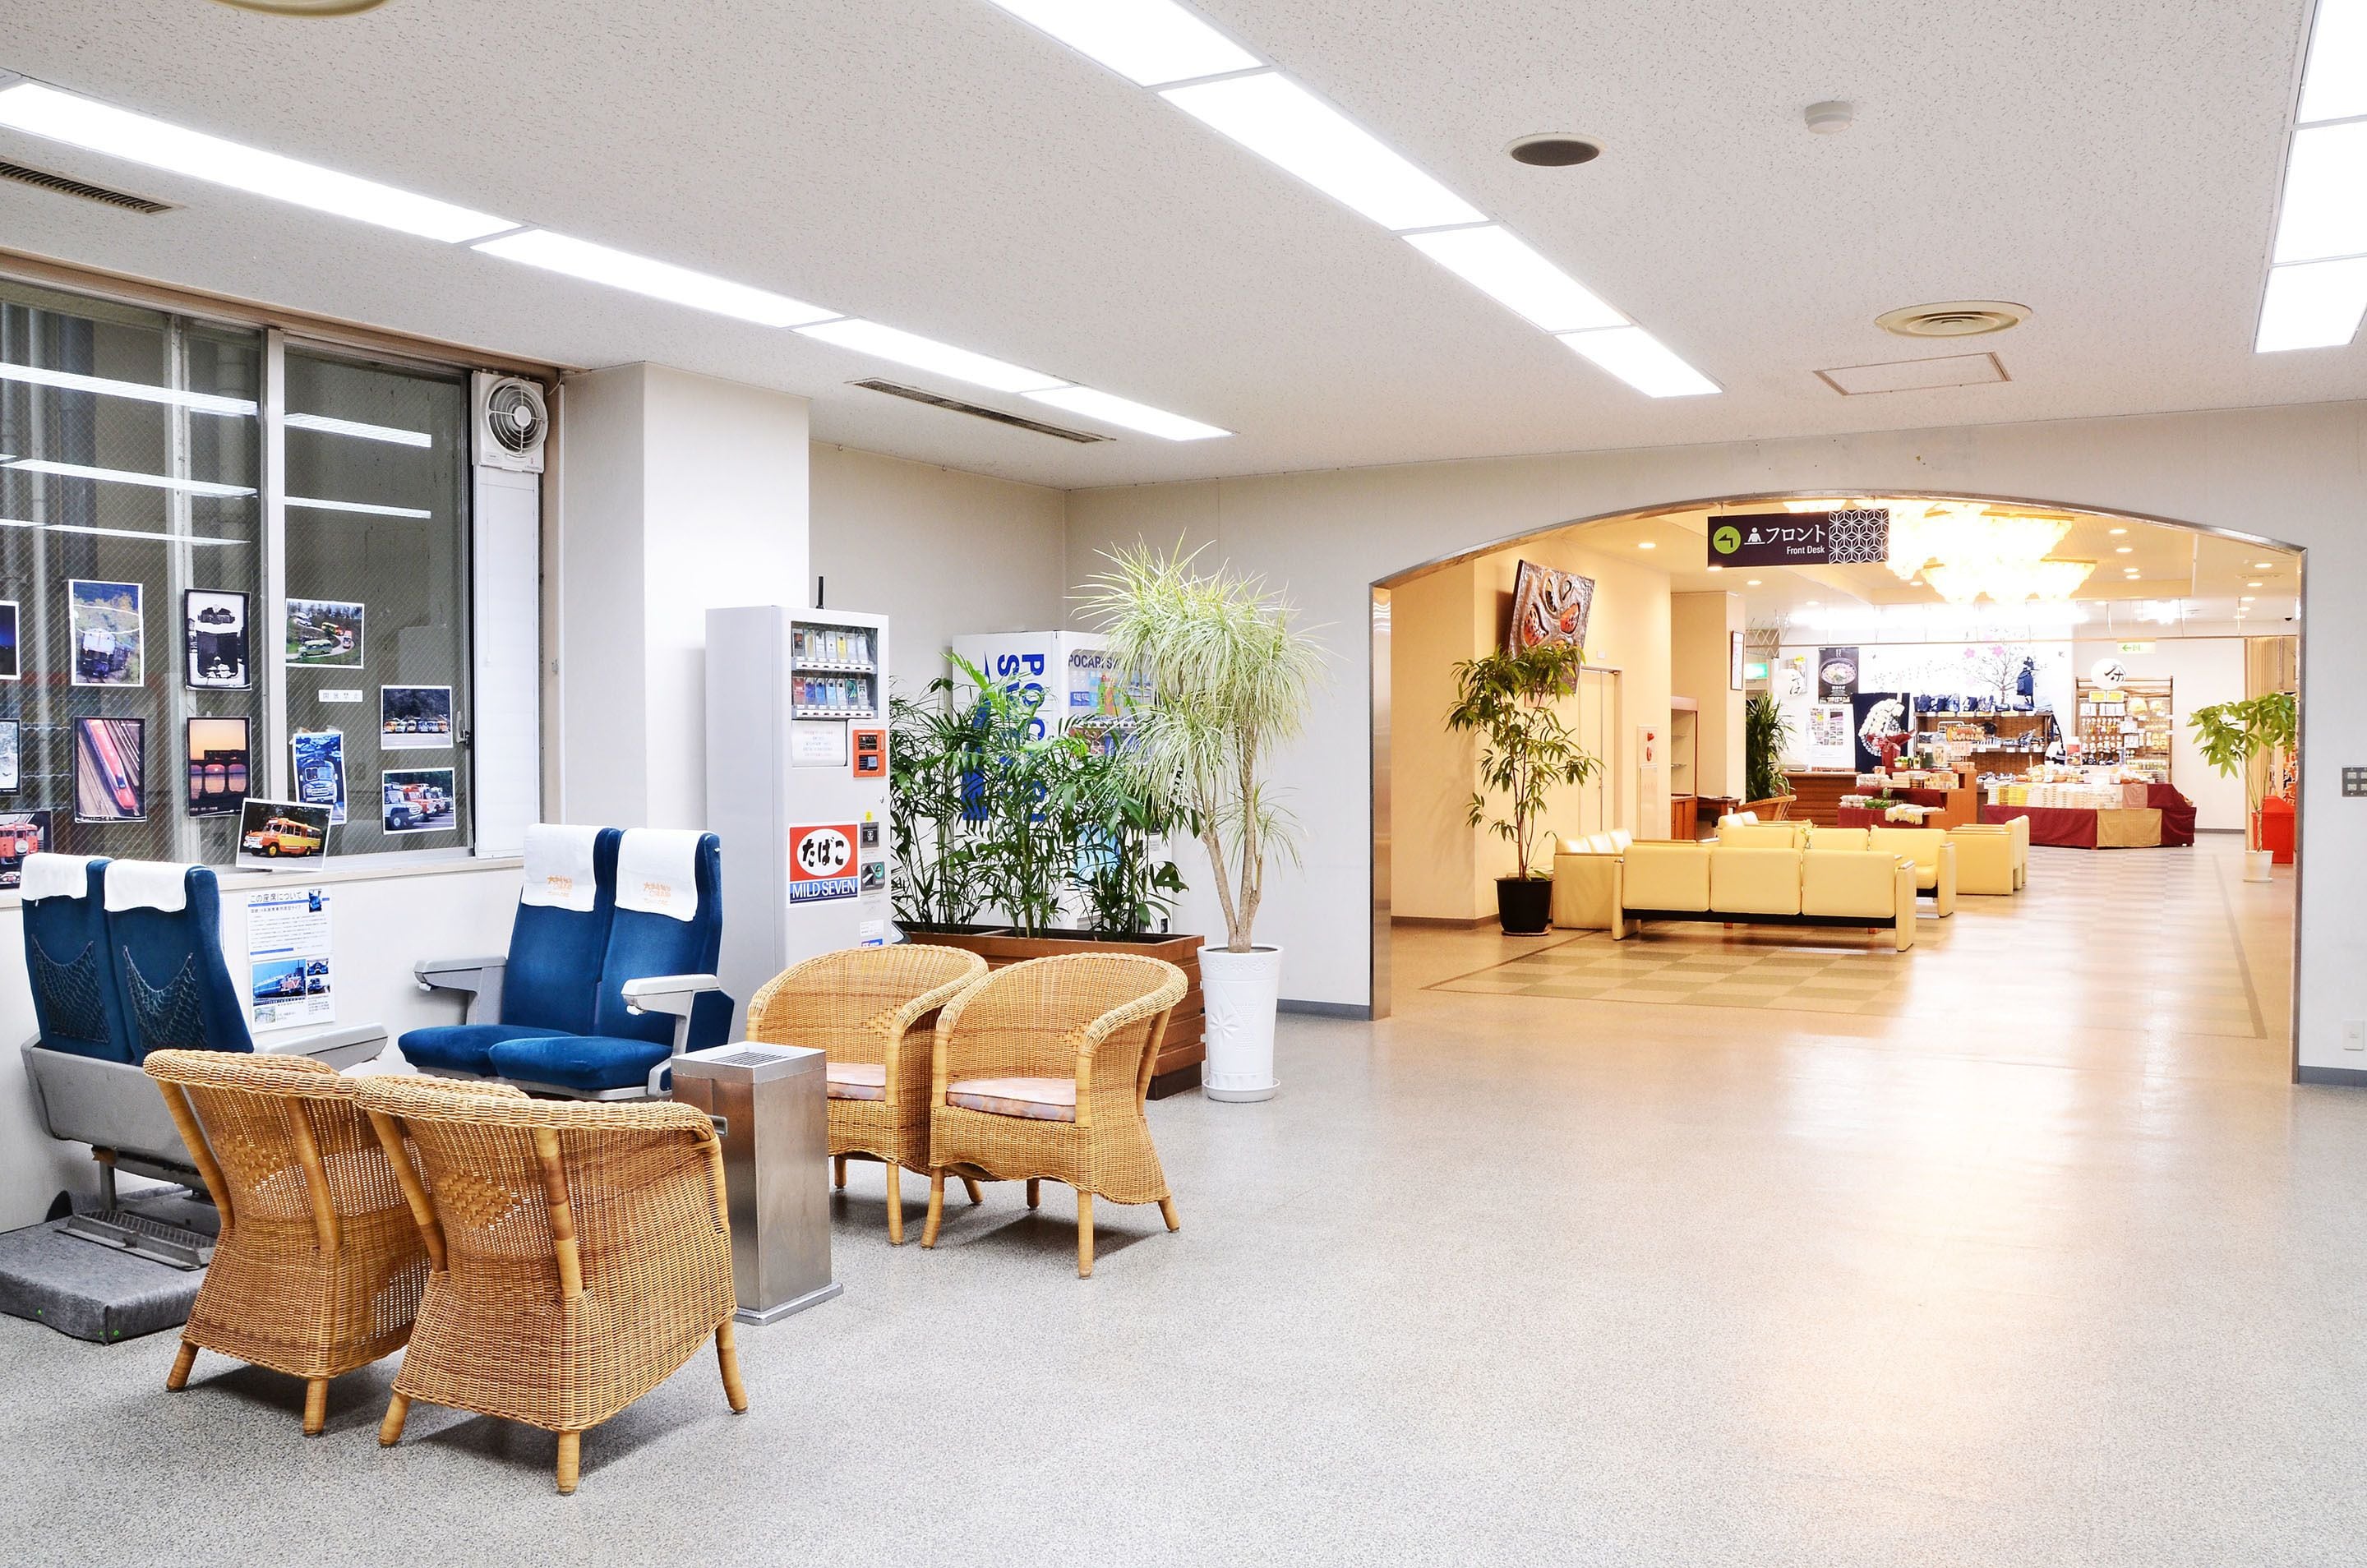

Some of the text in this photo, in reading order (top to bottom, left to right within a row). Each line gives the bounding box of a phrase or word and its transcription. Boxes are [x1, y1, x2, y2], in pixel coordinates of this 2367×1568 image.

[1765, 524, 1825, 544] フロント
[1787, 545, 1825, 555] Front Desk
[802, 837, 844, 867] たばこ
[792, 879, 855, 898] MILD SEVEN
